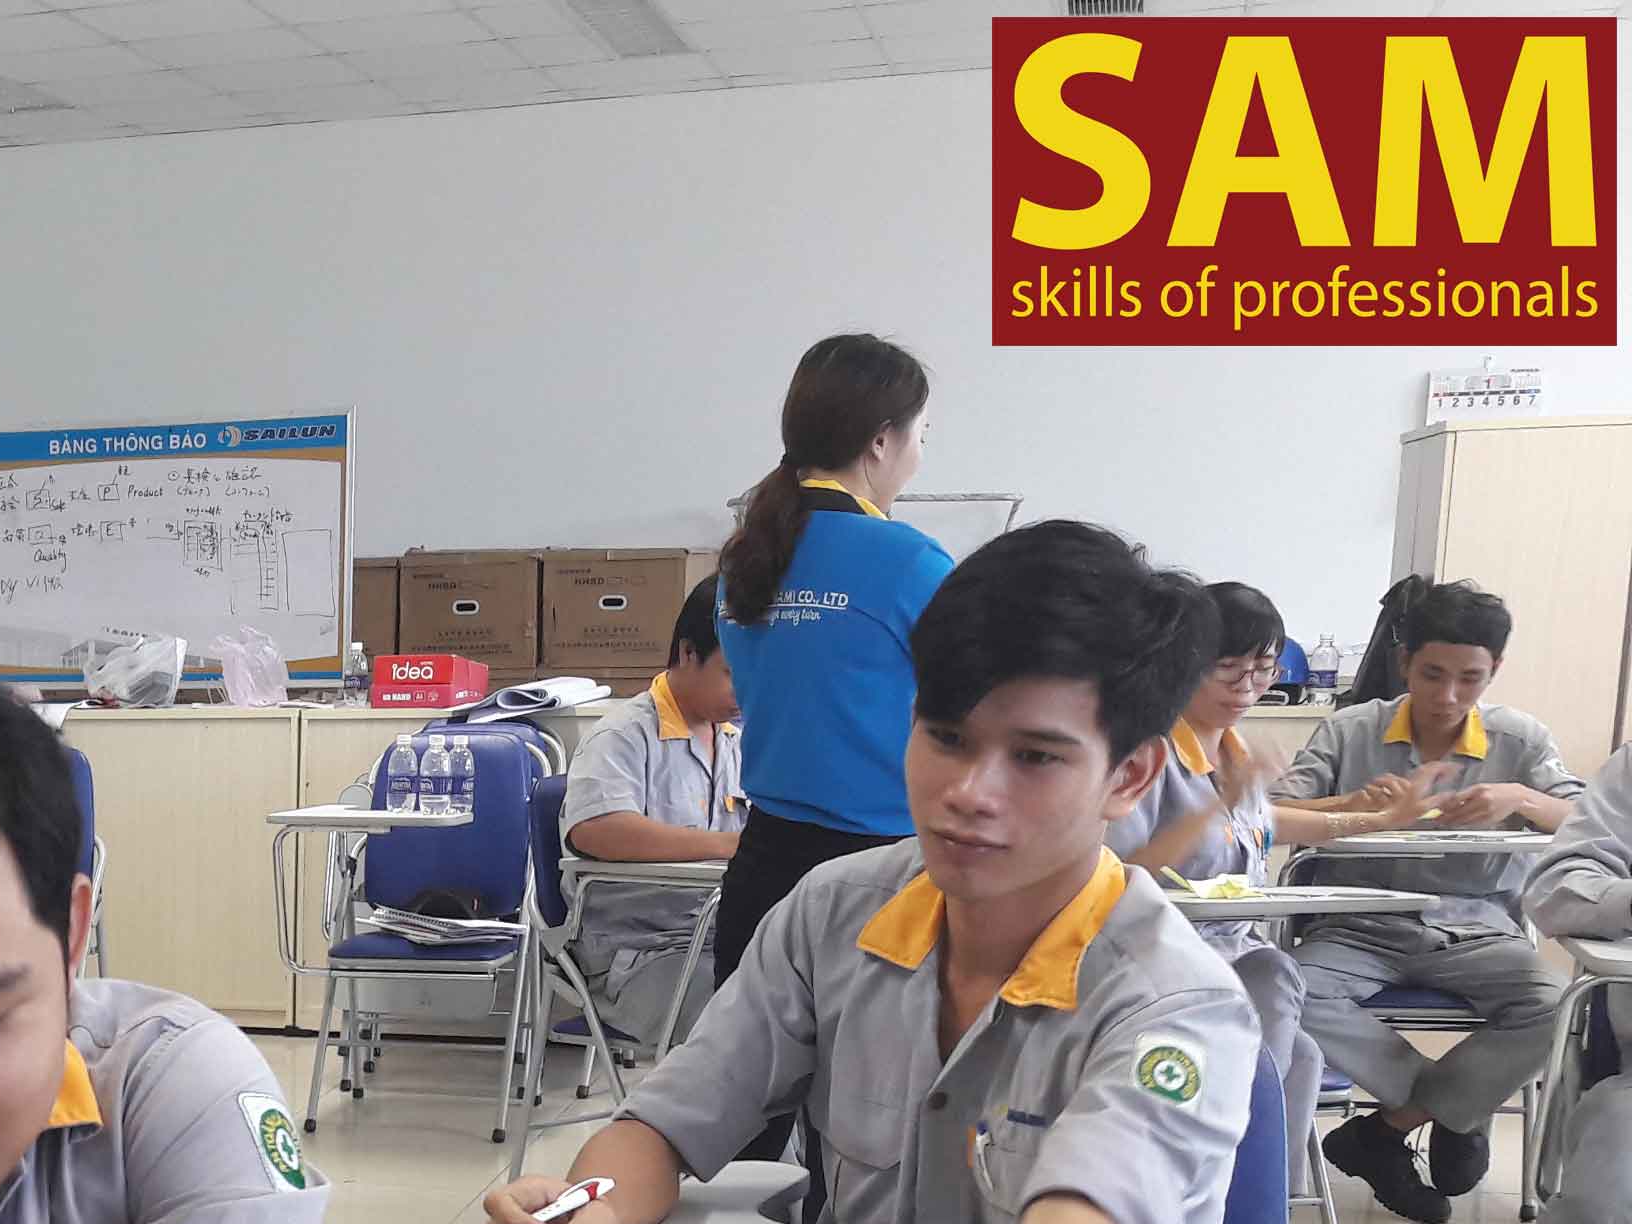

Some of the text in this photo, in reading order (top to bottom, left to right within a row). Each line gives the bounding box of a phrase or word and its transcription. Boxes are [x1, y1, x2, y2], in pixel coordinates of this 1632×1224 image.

[242, 424, 337, 441] SAILUN
[103, 432, 163, 452] THÔNG
[127, 484, 163, 497] Product
[823, 591, 848, 606] LTD
[392, 661, 434, 680] idea
